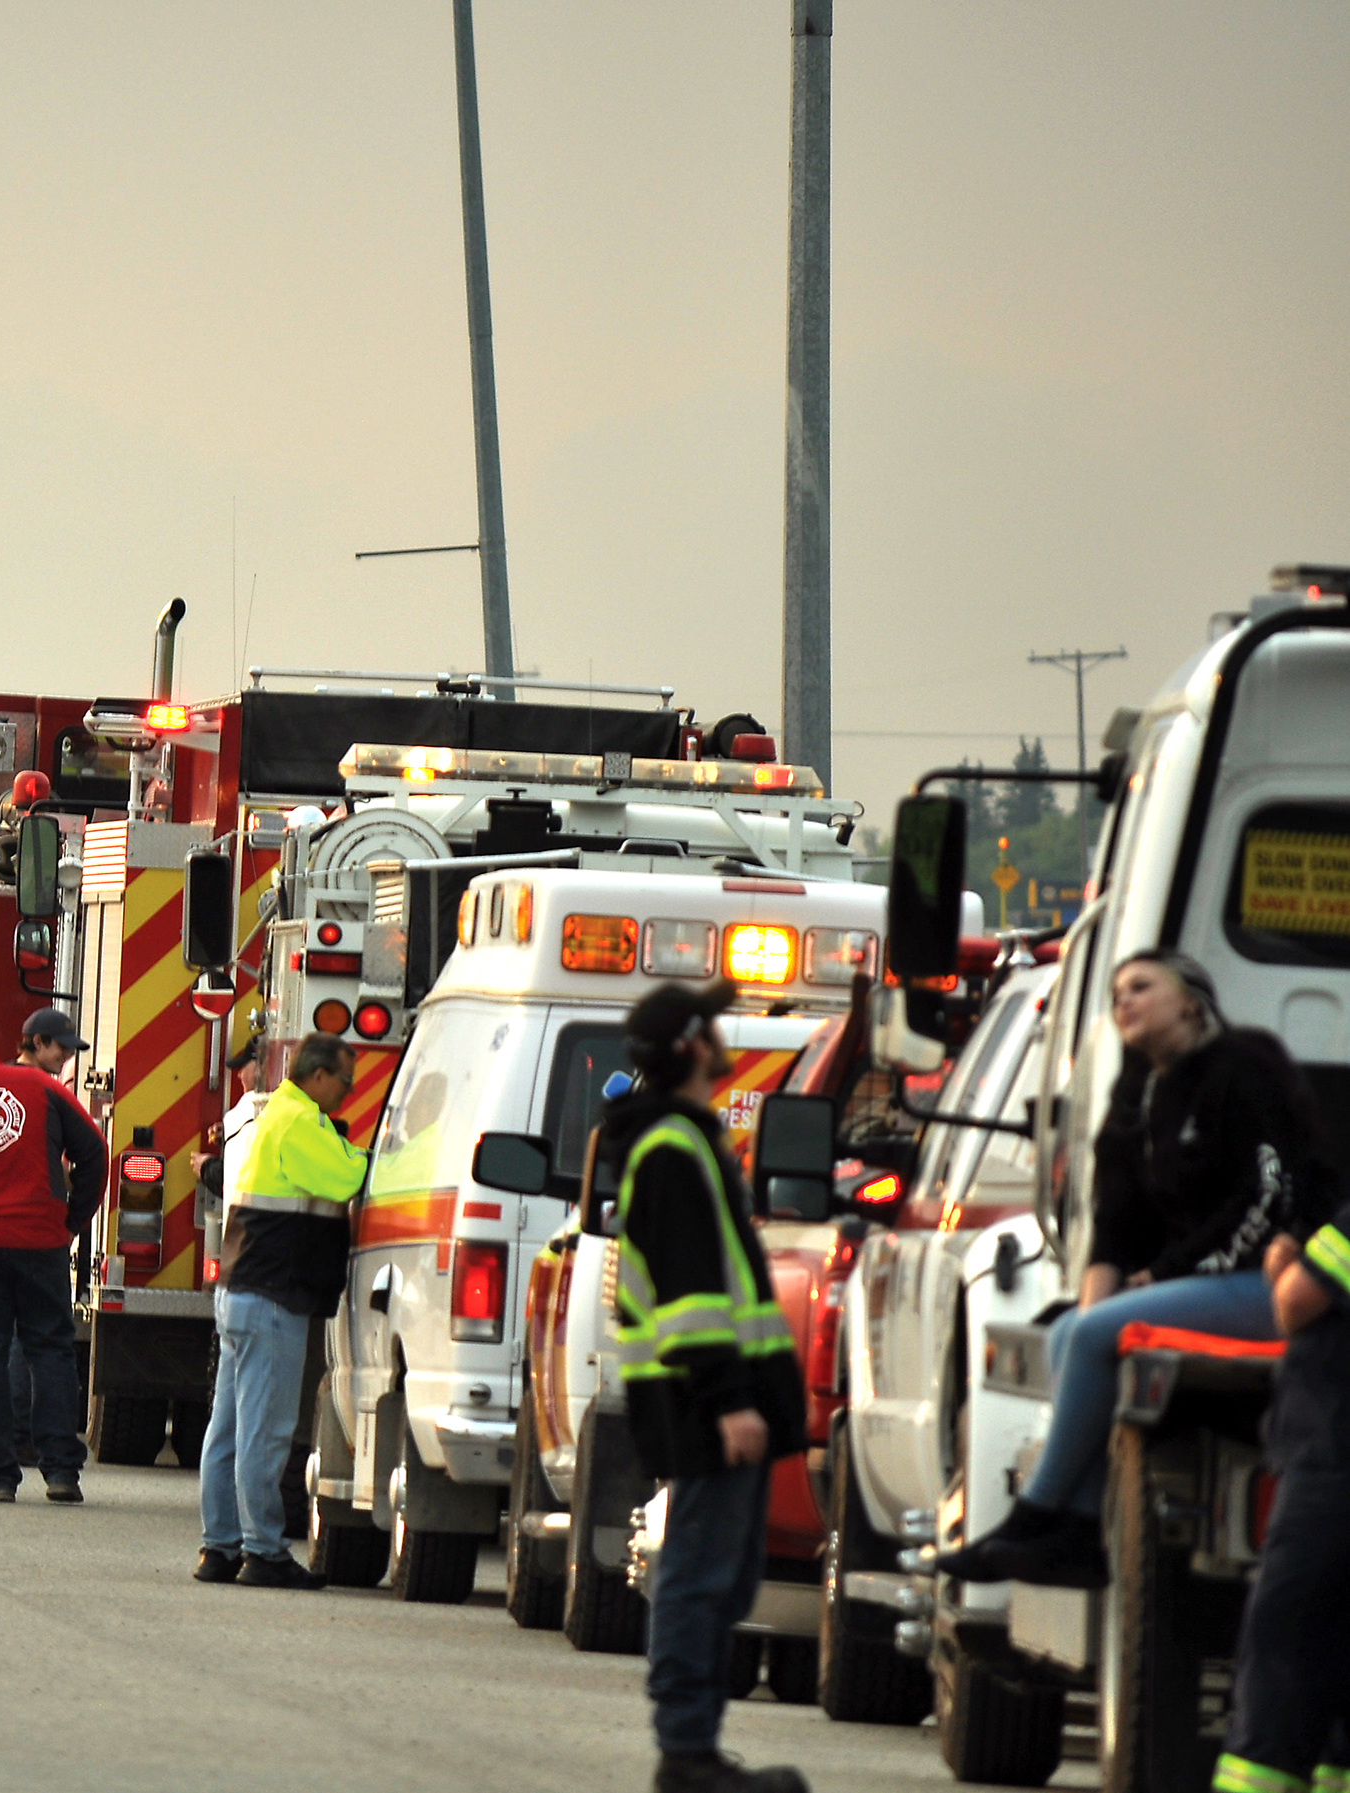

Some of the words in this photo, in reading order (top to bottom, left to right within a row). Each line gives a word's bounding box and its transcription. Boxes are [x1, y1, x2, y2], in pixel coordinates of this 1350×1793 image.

[1254, 851, 1303, 869] SLOW
[1310, 853, 1350, 872] DOW
[1257, 870, 1304, 890] MOVE
[1312, 873, 1350, 893] OVE
[1250, 892, 1300, 911] SAVE
[1306, 896, 1350, 915] LIVE
[729, 1089, 763, 1107] FIR
[716, 1106, 753, 1130] RES
